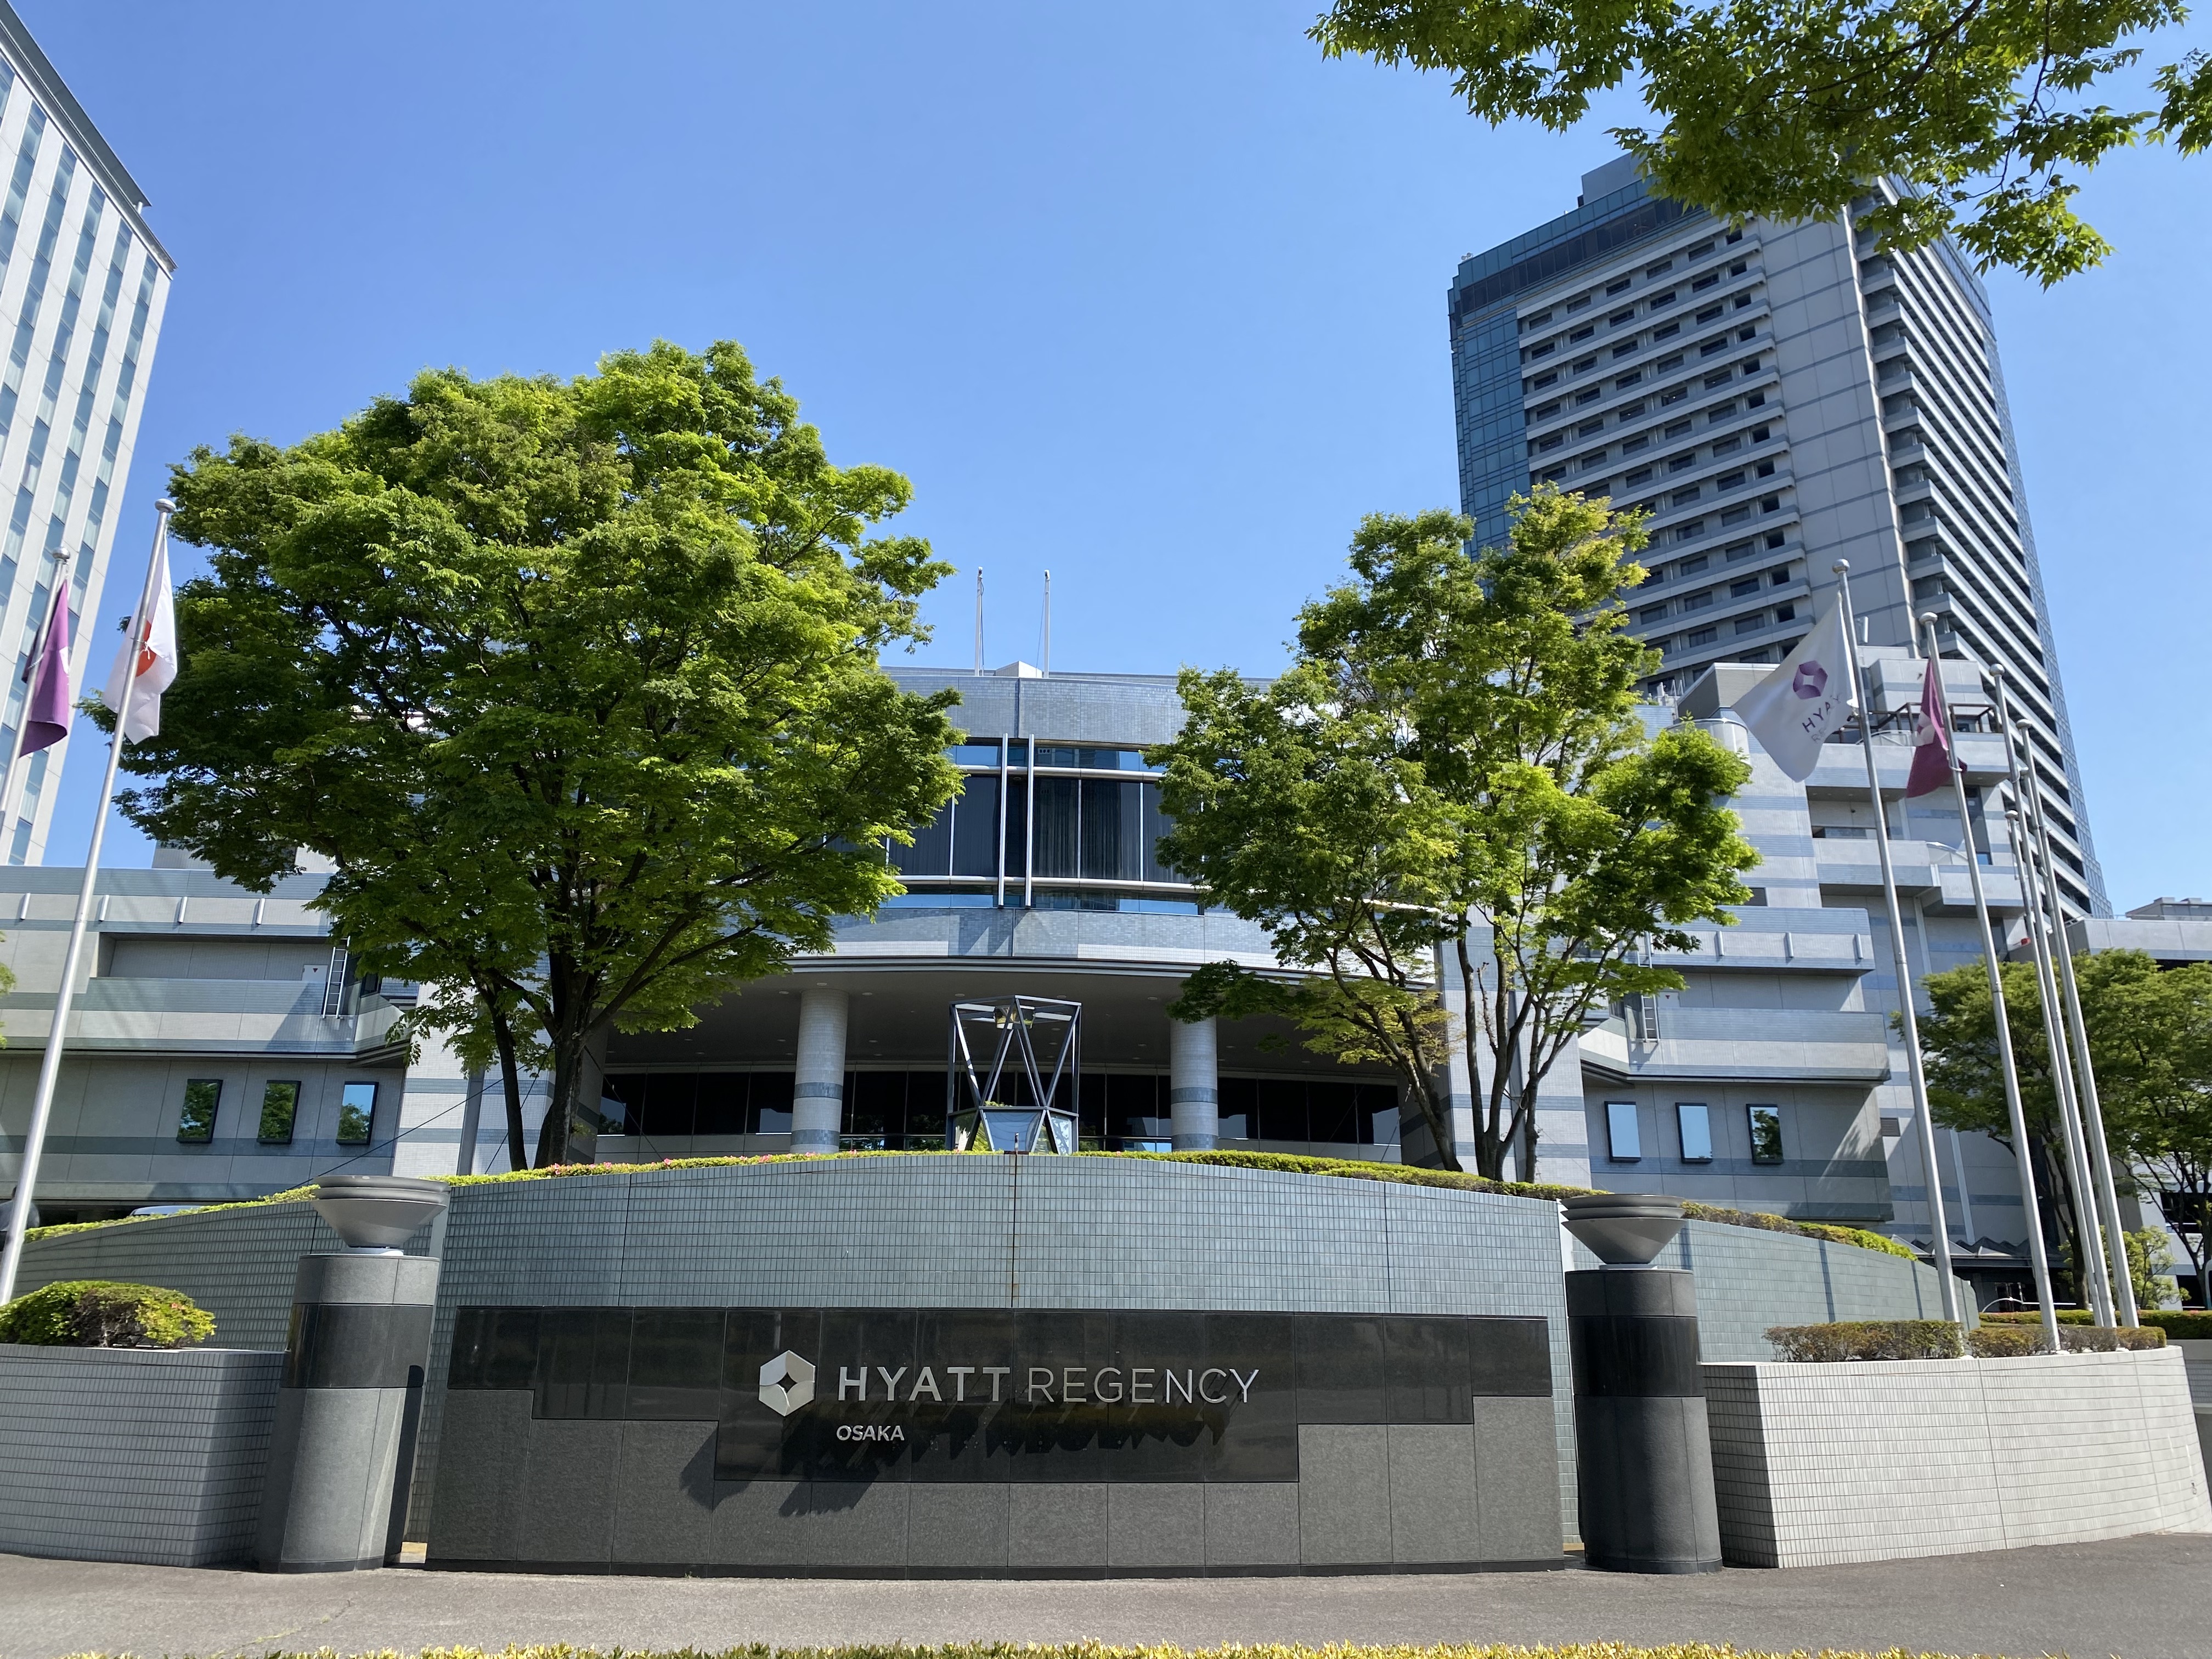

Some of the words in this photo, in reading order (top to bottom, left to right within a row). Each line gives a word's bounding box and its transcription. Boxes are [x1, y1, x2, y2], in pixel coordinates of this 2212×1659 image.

[837, 1366, 1011, 1402] HYATT
[1028, 1367, 1260, 1403] REGENCY
[836, 1425, 905, 1441] OSAKA
